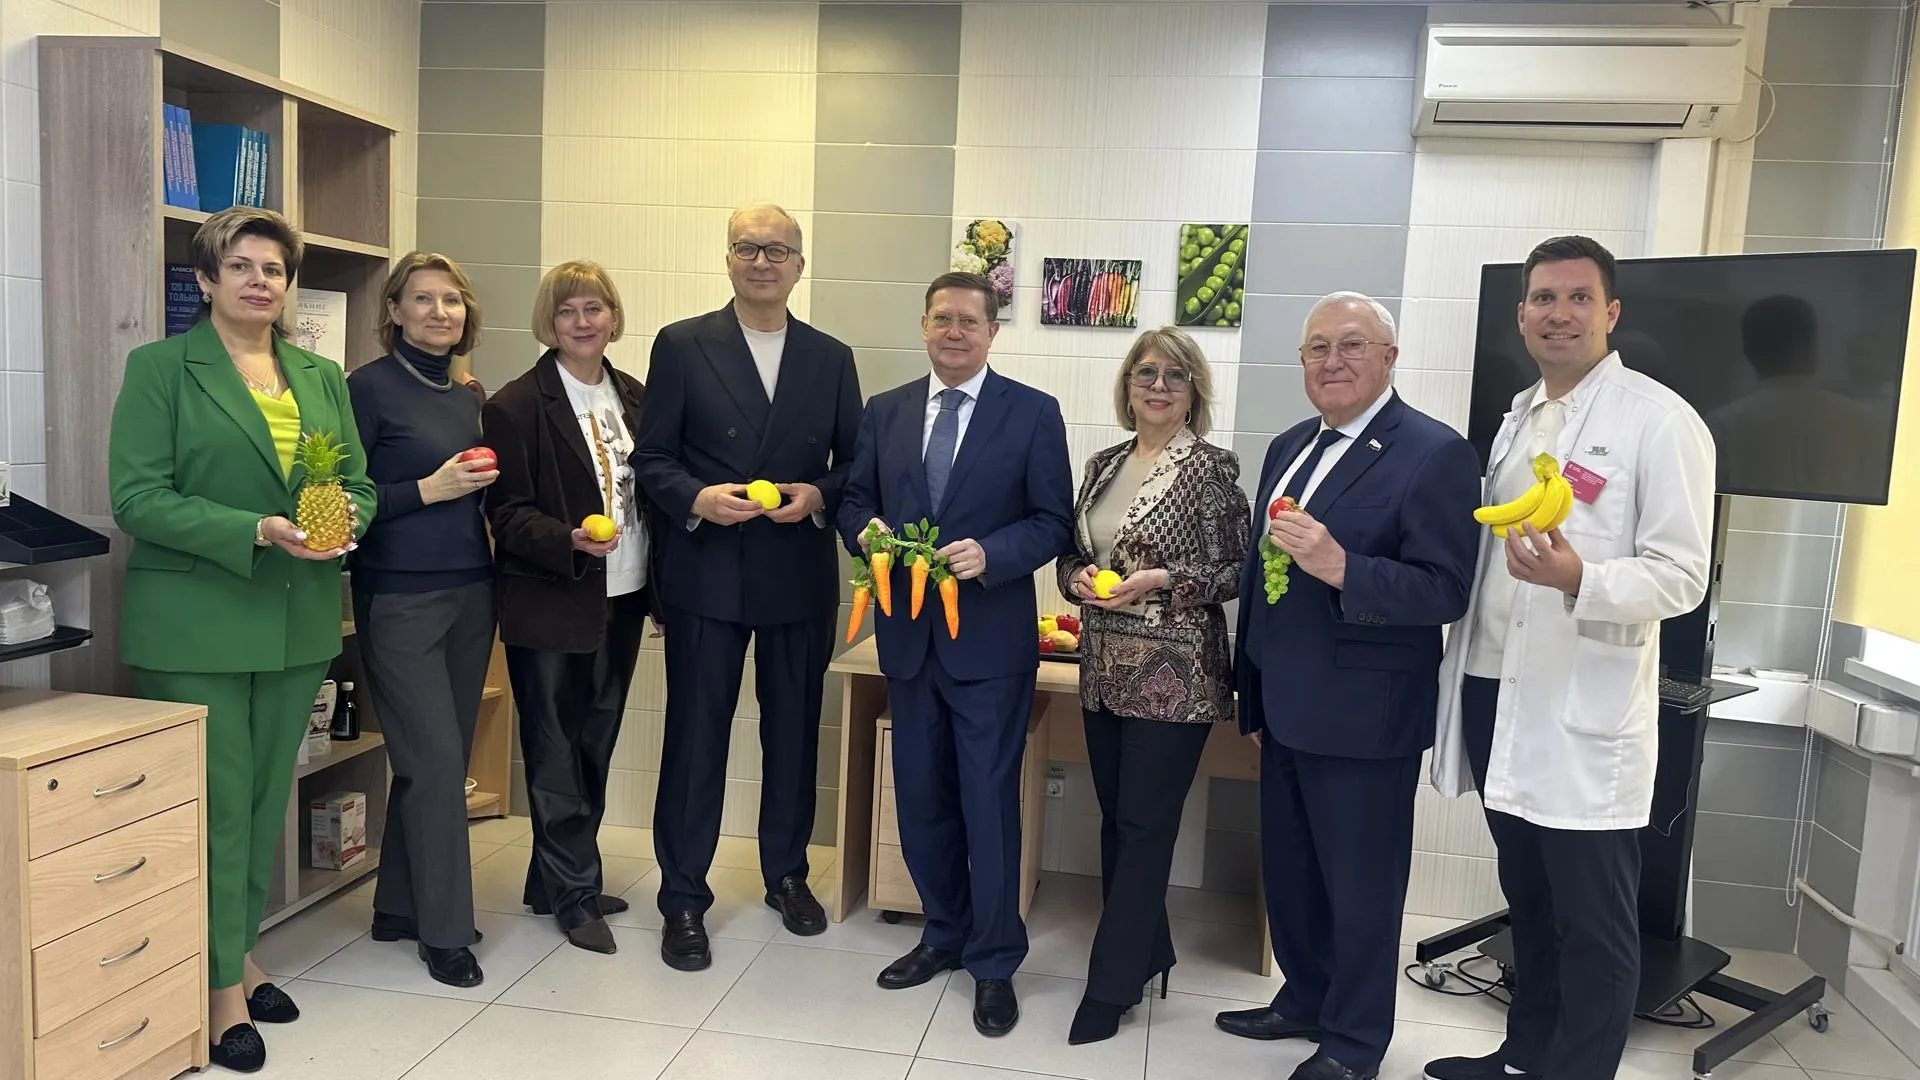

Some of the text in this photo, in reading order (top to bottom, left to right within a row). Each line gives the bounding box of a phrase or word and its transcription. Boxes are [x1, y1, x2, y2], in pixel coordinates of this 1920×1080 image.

[170, 282, 199, 293] 120 ЛЕТ
[168, 292, 200, 303] ТОЛЬКО
[299, 302, 326, 310] АКИНГ
